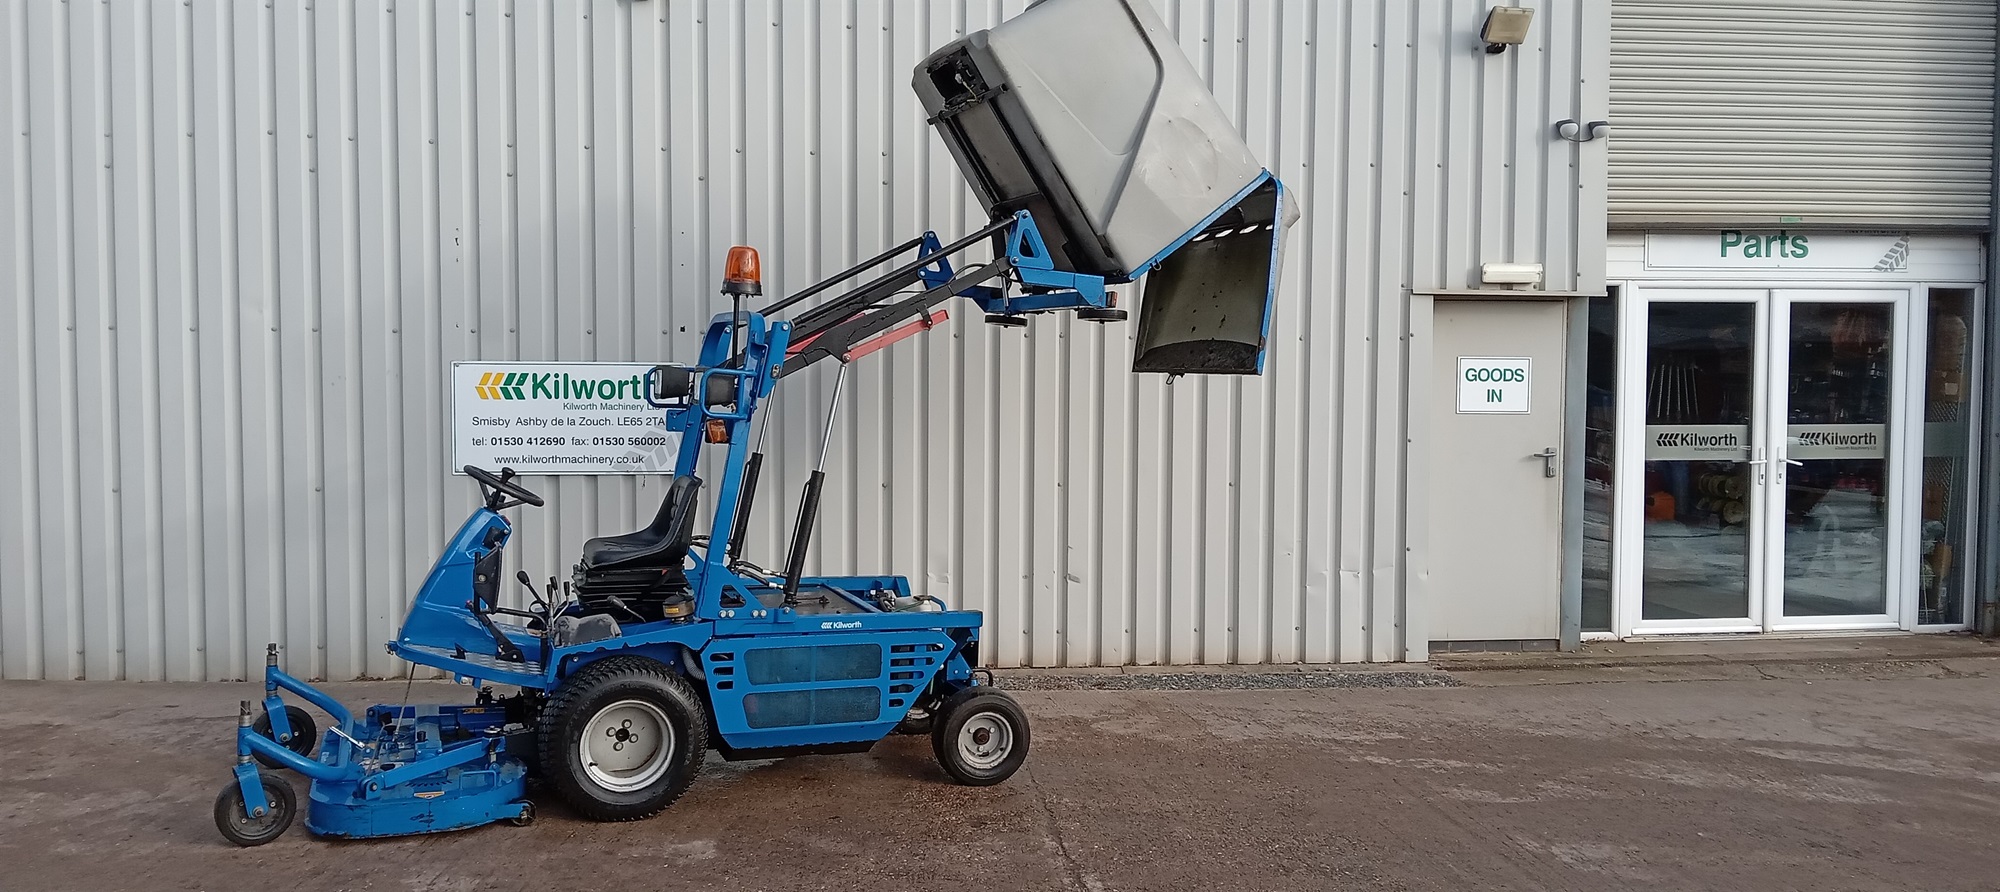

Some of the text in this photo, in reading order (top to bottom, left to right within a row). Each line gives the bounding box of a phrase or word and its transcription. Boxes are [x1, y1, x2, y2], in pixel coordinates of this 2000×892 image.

[1720, 229, 1809, 259] Parts
[1465, 368, 1525, 382] GOODS
[1487, 389, 1502, 403] IN
[563, 402, 598, 411] Kilworth
[600, 402, 645, 412] Machinery
[472, 416, 665, 428] Smisby Ashby de la Zouch. LE65 2TA
[472, 437, 666, 446] tel: 01530 412690 fax: 01530 560002
[1680, 433, 1738, 447] Kilworth
[1822, 432, 1877, 446] Kilworth
[494, 455, 645, 466] www.kilworthmachinery.co.uk
[833, 620, 862, 629] Kilworth
